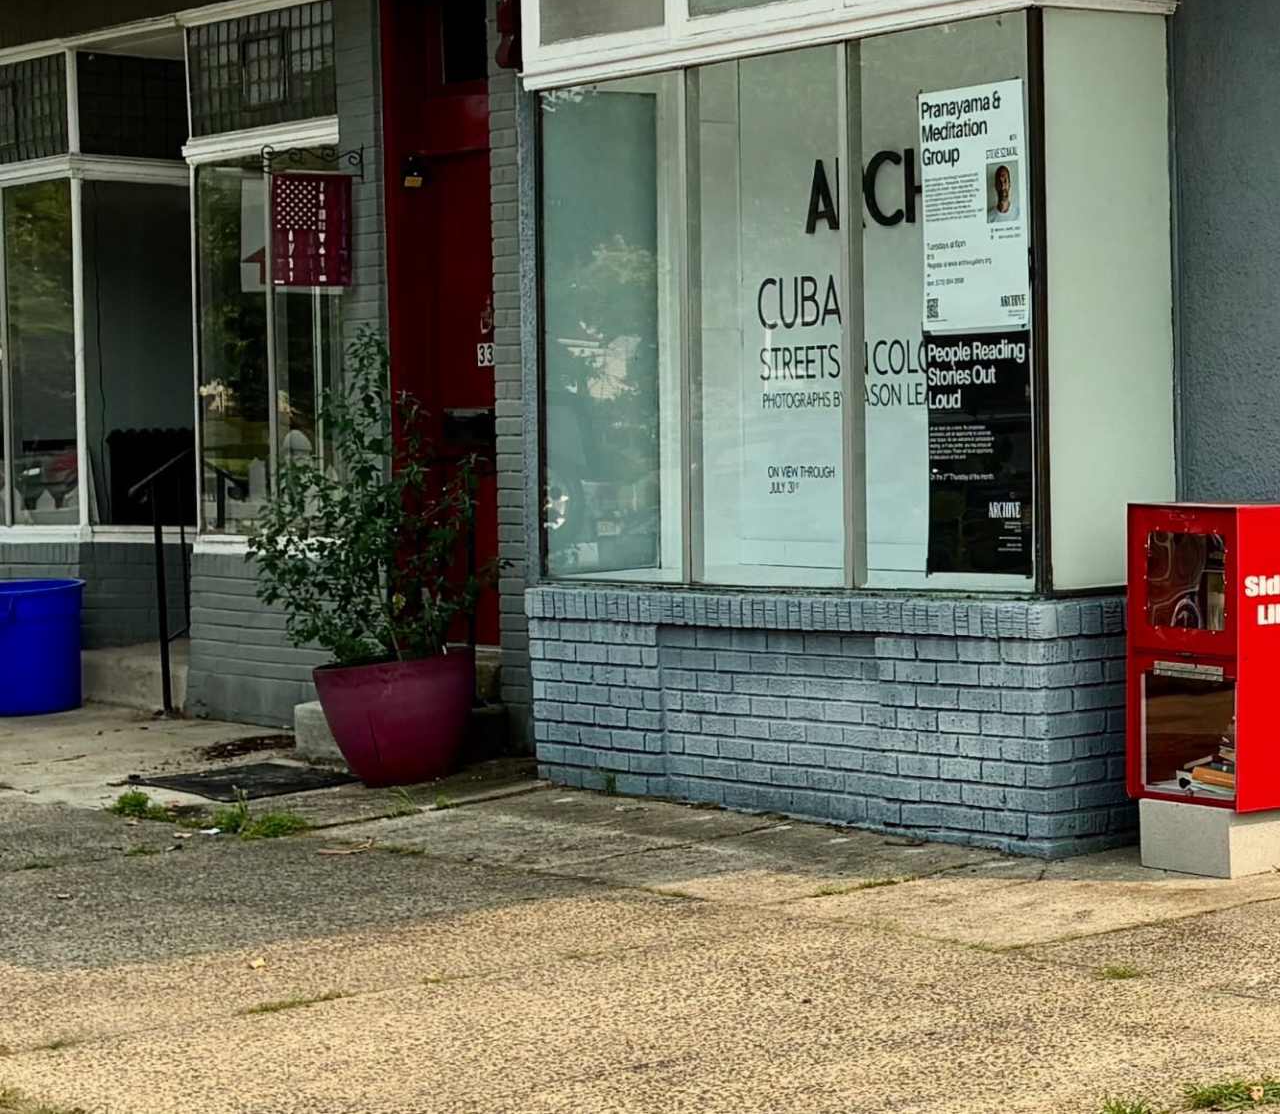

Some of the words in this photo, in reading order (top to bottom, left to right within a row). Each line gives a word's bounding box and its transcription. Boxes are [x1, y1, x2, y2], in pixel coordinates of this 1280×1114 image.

[921, 96, 990, 120] Pranayama
[992, 90, 1001, 109] &
[922, 118, 988, 143] Meditation
[922, 147, 960, 167] Group
[757, 274, 842, 330] CUBA
[479, 344, 494, 365] 33
[760, 344, 841, 380] STREETS
[928, 341, 971, 366] People
[972, 339, 1026, 364] Reading
[928, 367, 971, 386] Stories
[973, 365, 996, 384] Out
[762, 392, 831, 408] PHOTOGRAPHS
[928, 388, 961, 409] Loud
[800, 466, 836, 478] THROUGH
